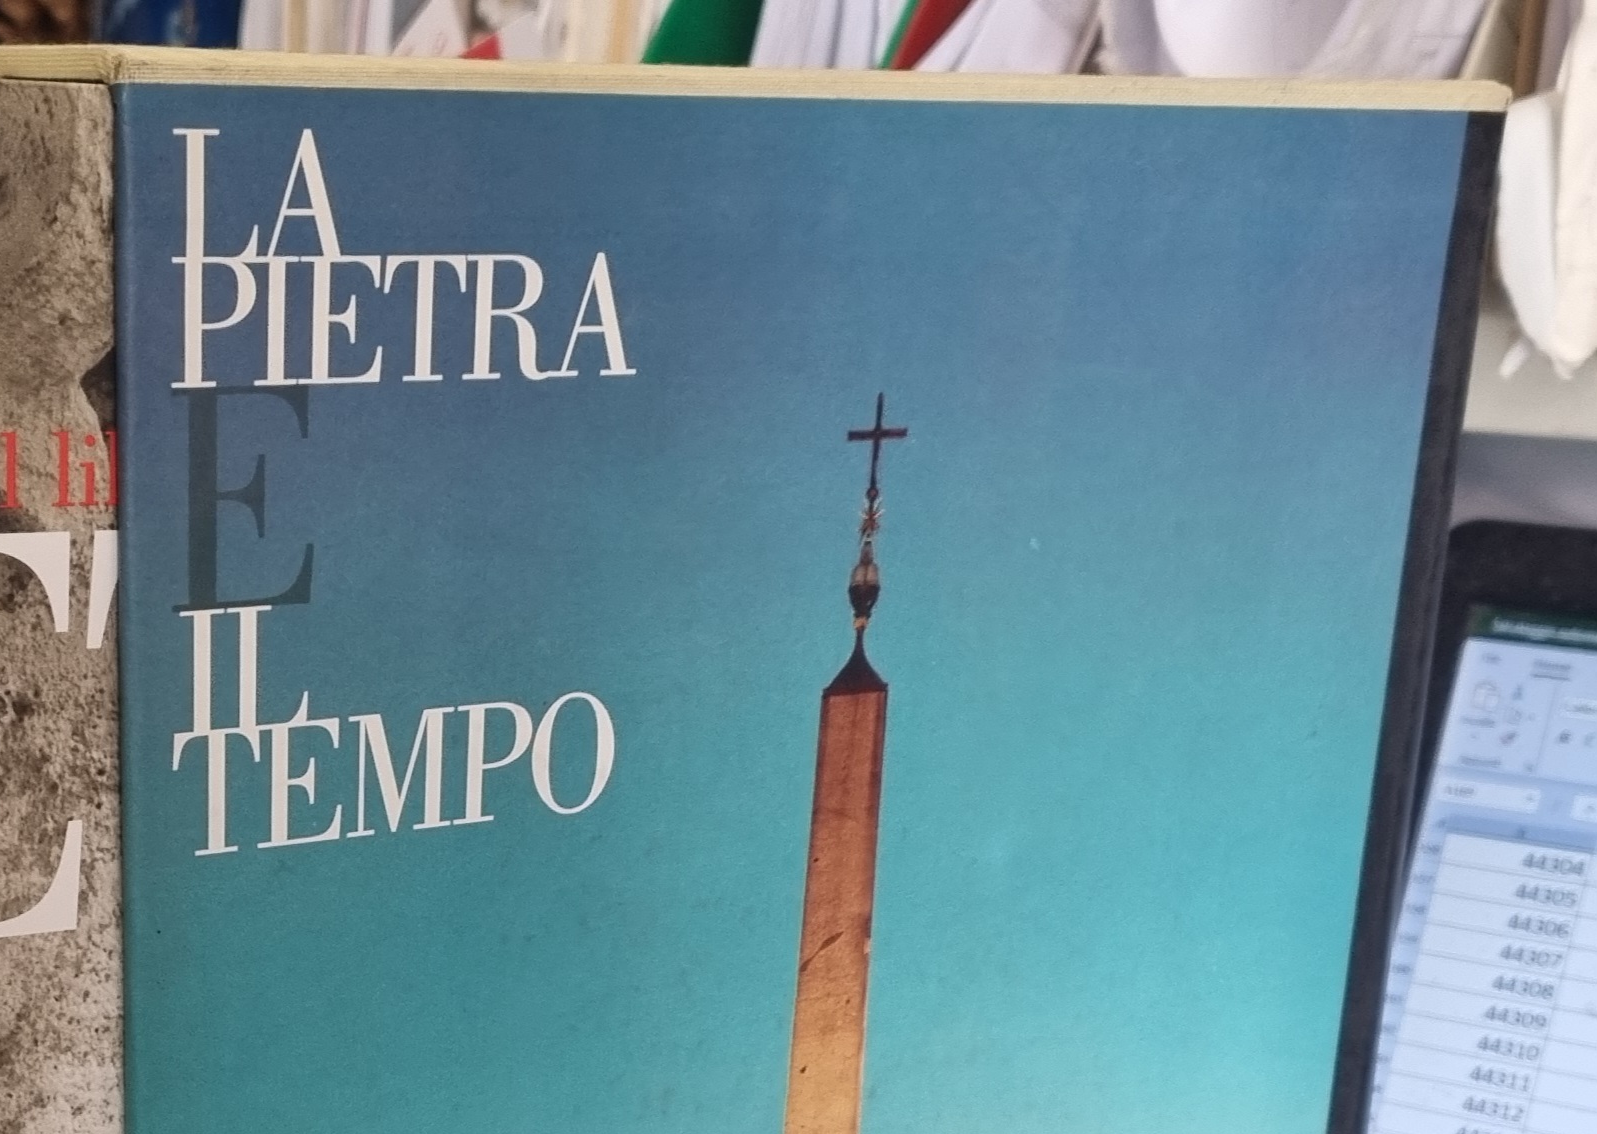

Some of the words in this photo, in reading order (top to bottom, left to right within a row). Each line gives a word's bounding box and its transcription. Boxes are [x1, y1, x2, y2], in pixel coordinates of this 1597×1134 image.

[172, 127, 343, 262] LA
[170, 252, 637, 390] PIETRA
[170, 384, 315, 613] E
[179, 604, 309, 736] IL
[172, 690, 616, 857] TEMPO
[1522, 852, 1585, 876] 44304
[1515, 883, 1579, 908] 44305
[1508, 914, 1571, 938] 44306
[1500, 944, 1563, 968] 44307
[1492, 974, 1554, 999] 44308
[1484, 1004, 1548, 1030] 44309
[1476, 1034, 1540, 1062] 44310
[1469, 1064, 1531, 1092] 44311
[1462, 1094, 1525, 1122] 44312
